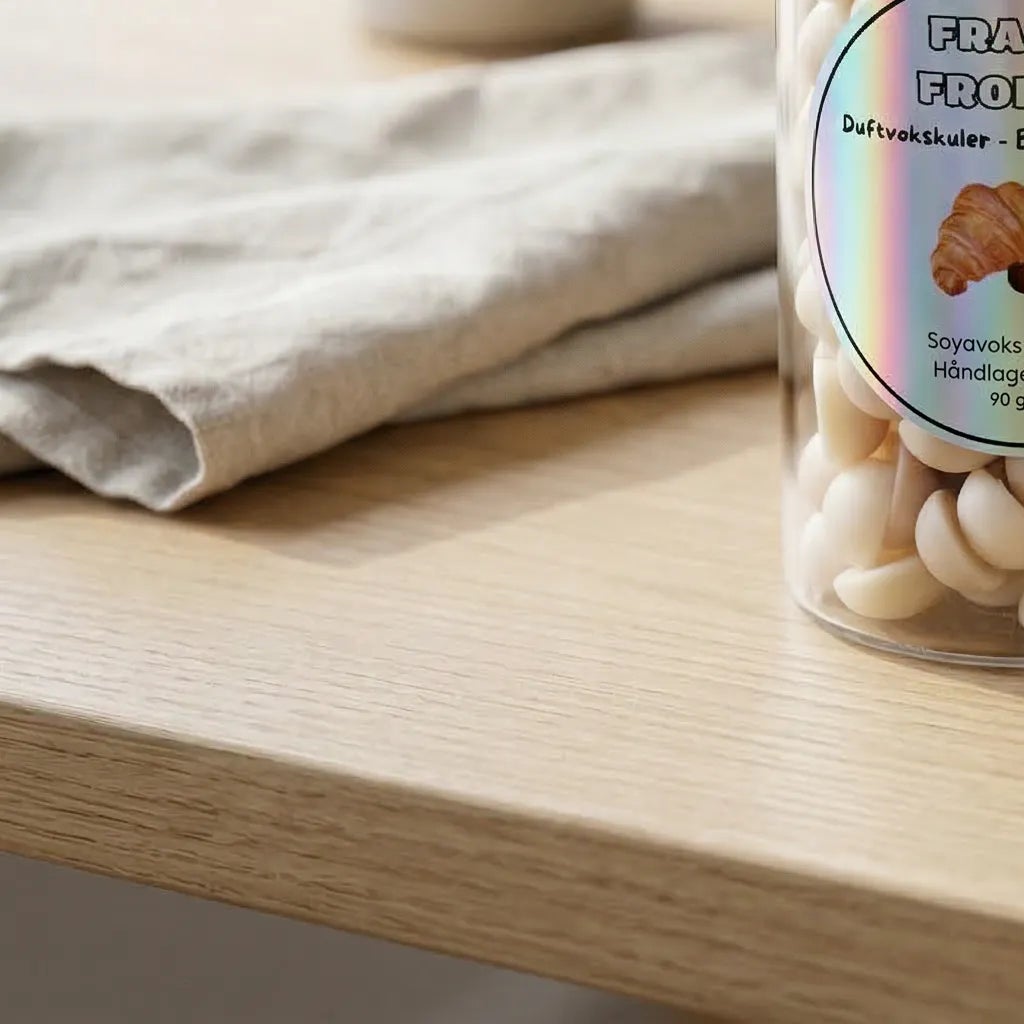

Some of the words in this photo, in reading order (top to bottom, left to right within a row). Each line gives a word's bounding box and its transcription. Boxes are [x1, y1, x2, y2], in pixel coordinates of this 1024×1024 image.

[842, 113, 991, 150] Duftvokskuler
[927, 331, 1022, 356] Soyavoks
[989, 391, 1011, 407] 90
